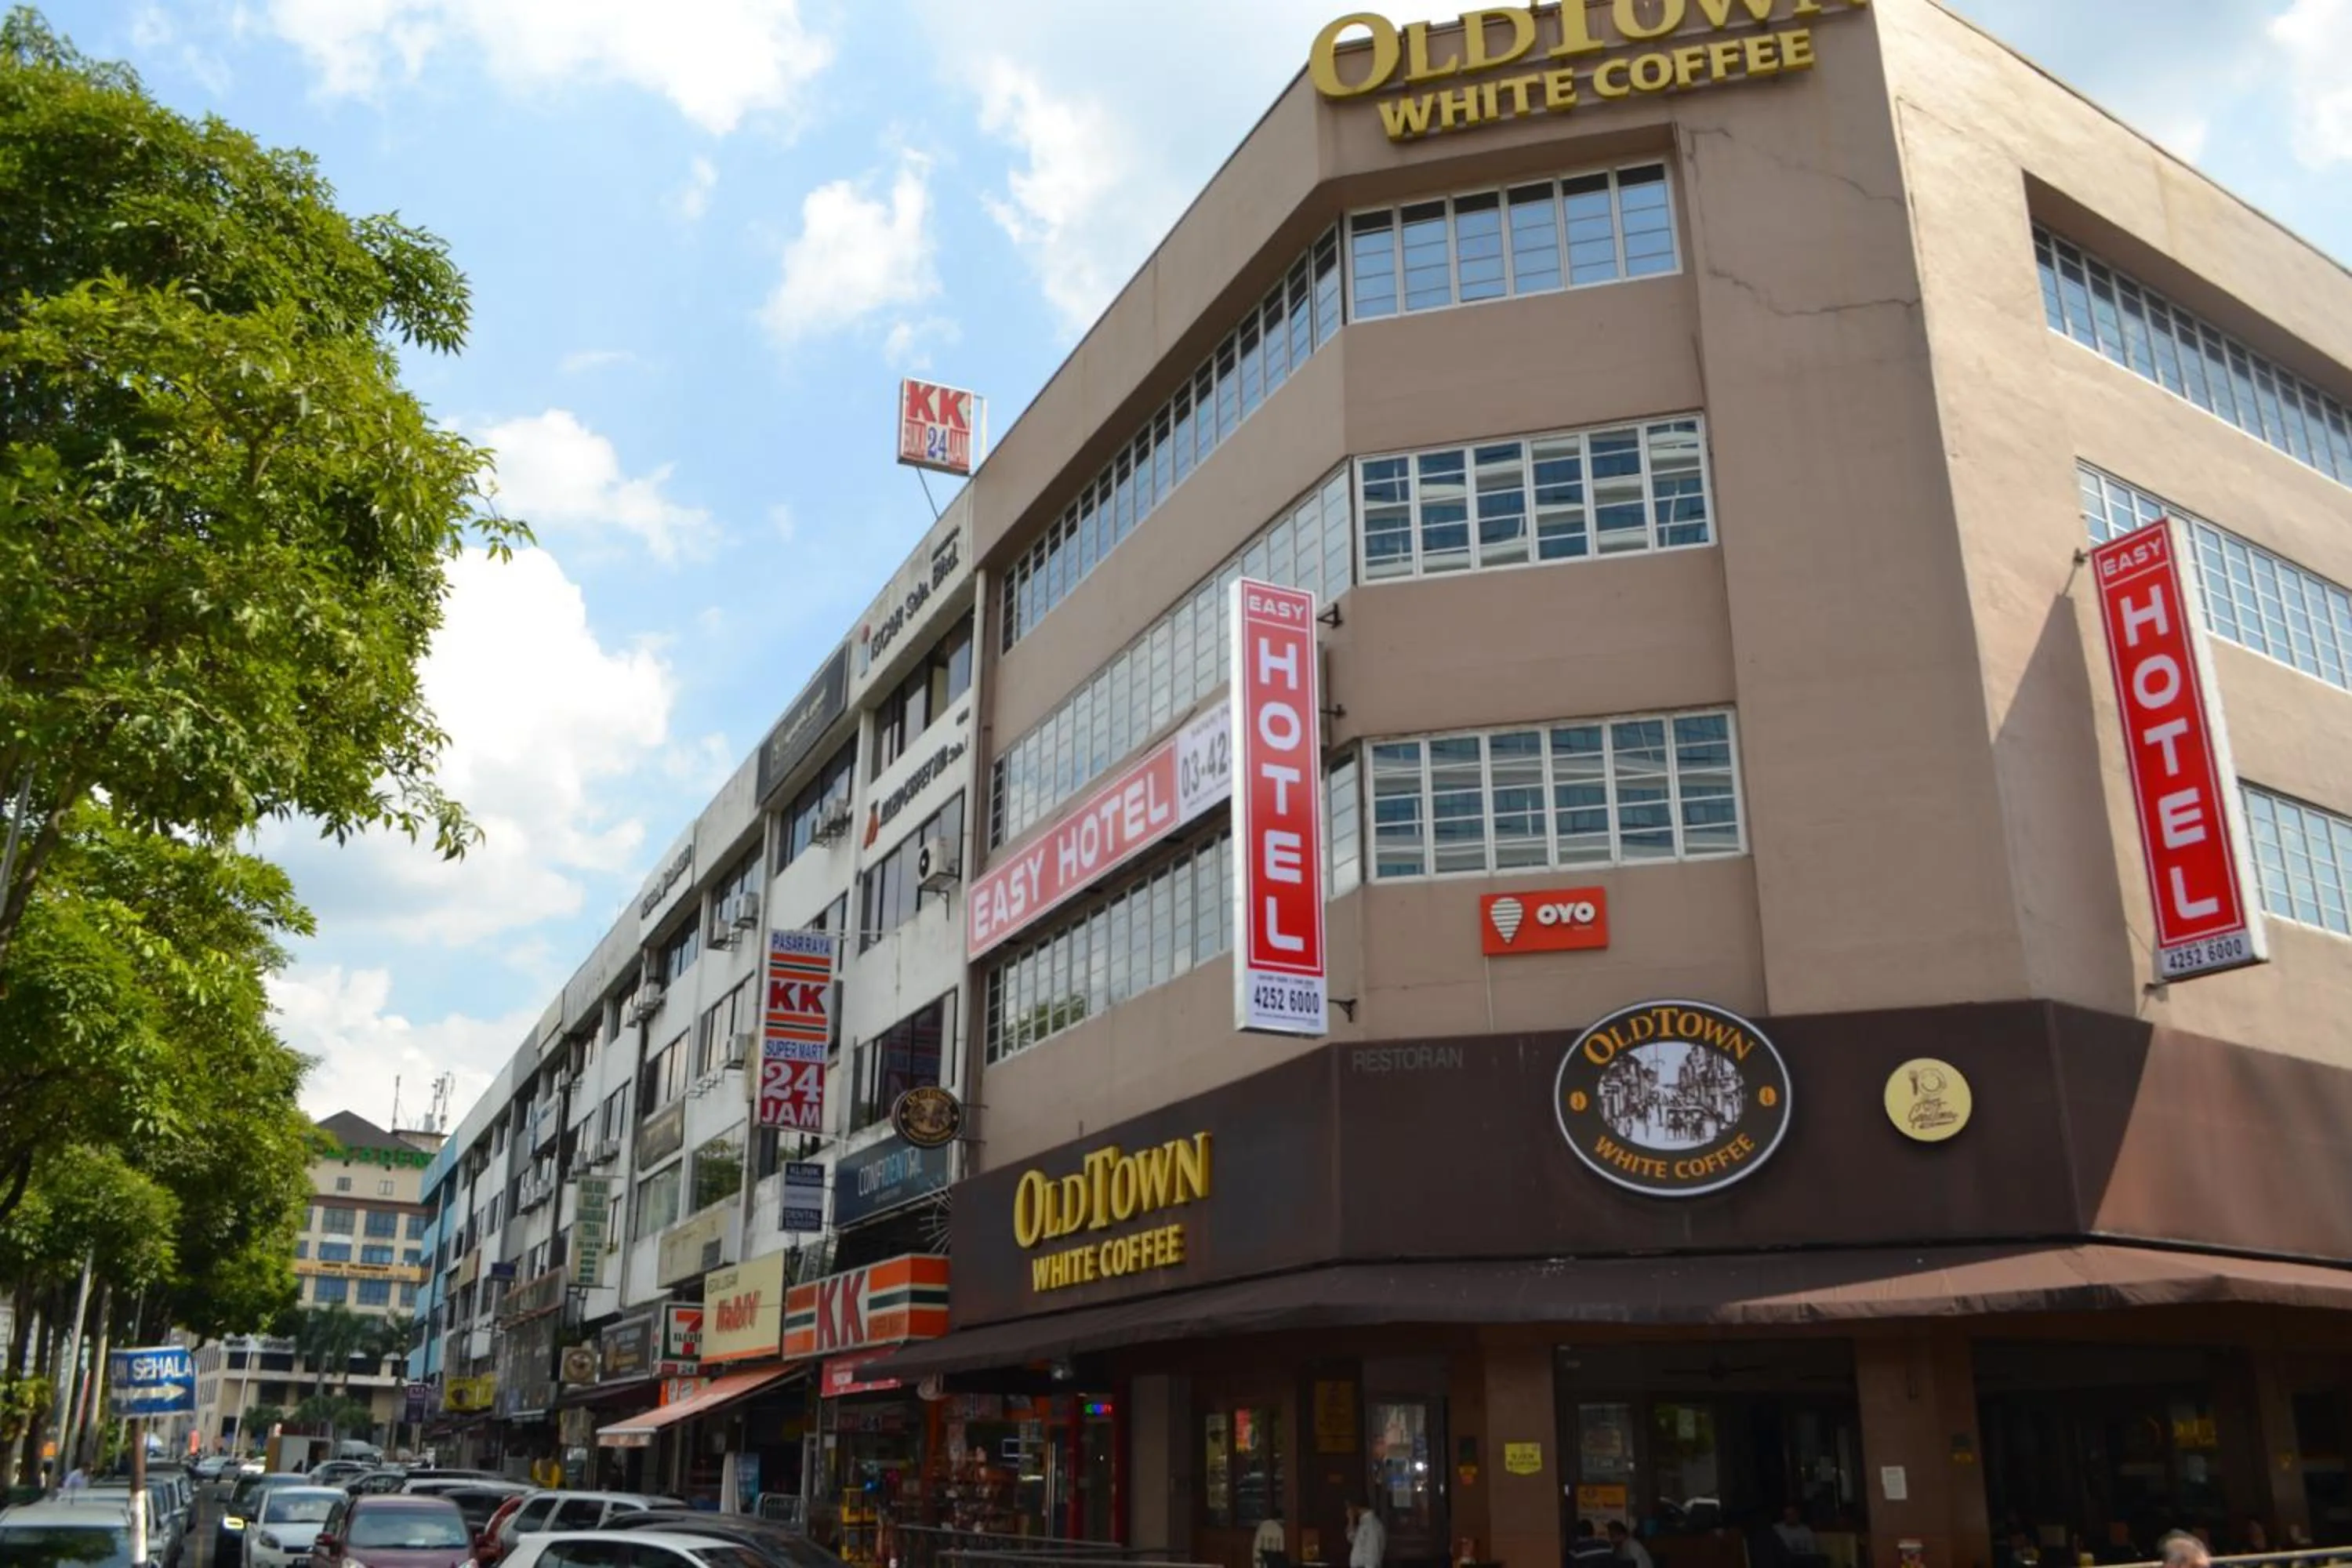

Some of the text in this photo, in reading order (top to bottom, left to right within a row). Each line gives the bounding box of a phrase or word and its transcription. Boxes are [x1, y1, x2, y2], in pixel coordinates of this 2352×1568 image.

[1378, 28, 1815, 142] WHITE COFFEE
[909, 381, 967, 430] KK
[927, 426, 946, 461] 24
[2103, 537, 2163, 578] EASY
[1247, 594, 1306, 621] EASY
[1181, 729, 1232, 800] 03-42
[2119, 583, 2220, 920] HOTEL
[1258, 637, 1305, 952] HOTEL
[974, 848, 1046, 943] EASY
[1058, 771, 1168, 886] HOTEL
[1536, 901, 1596, 925] OYO
[2169, 949, 2202, 970] 4252
[2207, 938, 2242, 961] 6000
[769, 980, 827, 1014] KK
[1254, 985, 1320, 1014] 4252 6000
[1584, 1007, 1756, 1065] OLDTOWN
[1352, 1047, 1464, 1073] RESTORAN
[764, 1062, 822, 1102] 24
[761, 1100, 821, 1127] JAM
[1593, 1133, 1756, 1179] WHITE COFFEE
[1014, 1131, 1212, 1249] OLDTOWN
[1032, 1223, 1184, 1292] WHITE COFFEE
[816, 1269, 866, 1351] KK
[132, 1354, 194, 1381] SEHALA
